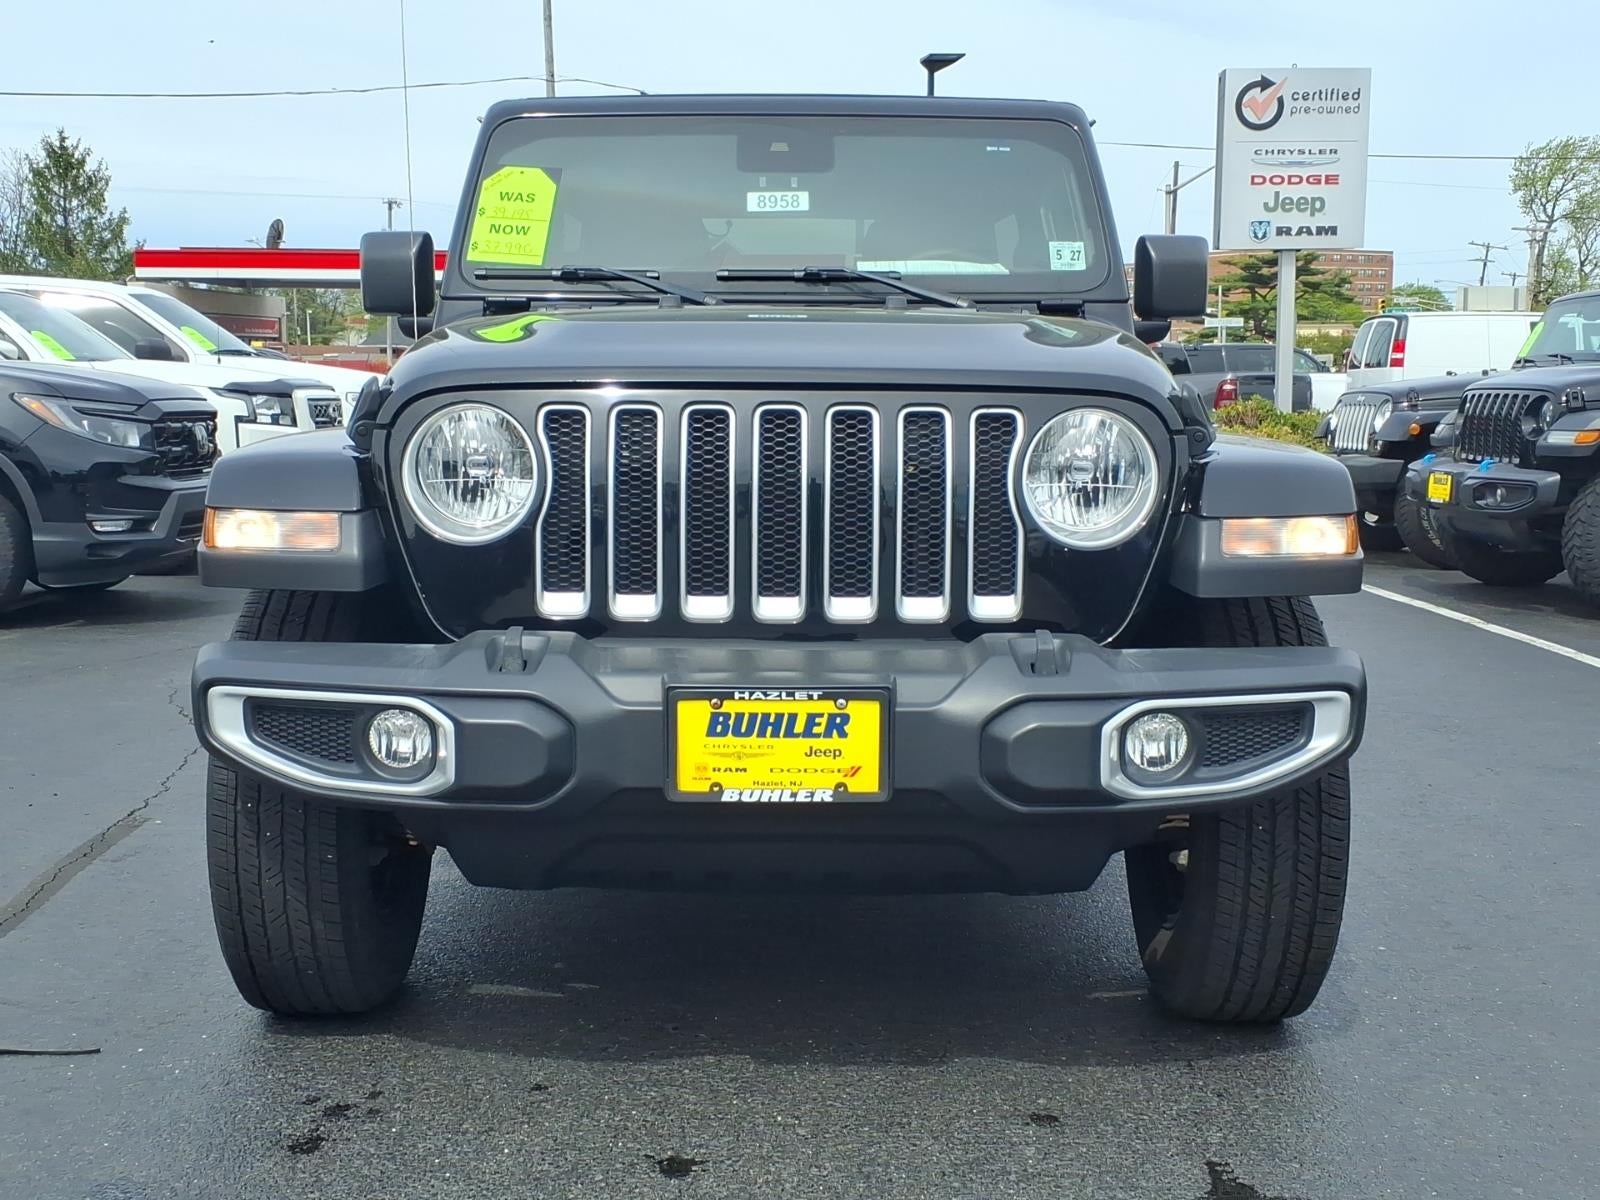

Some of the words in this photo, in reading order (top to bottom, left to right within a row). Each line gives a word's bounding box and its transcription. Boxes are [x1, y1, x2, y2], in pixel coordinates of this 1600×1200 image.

[1291, 88, 1361, 101] certified
[1290, 104, 1360, 117] pre-owned
[1254, 148, 1338, 156] CHRYSLER
[1250, 174, 1340, 186] DODGE
[500, 191, 536, 203] WAS
[757, 194, 800, 209] 8958
[1263, 191, 1327, 217] Jeep
[489, 223, 531, 236] NOW
[1275, 225, 1338, 237] RAM
[1056, 249, 1062, 260] 5
[1070, 250, 1081, 261] 27
[734, 691, 823, 700] HAZLET
[705, 711, 851, 738] BUHLER
[804, 746, 842, 759] Jeep
[721, 788, 834, 802] BUHLER
